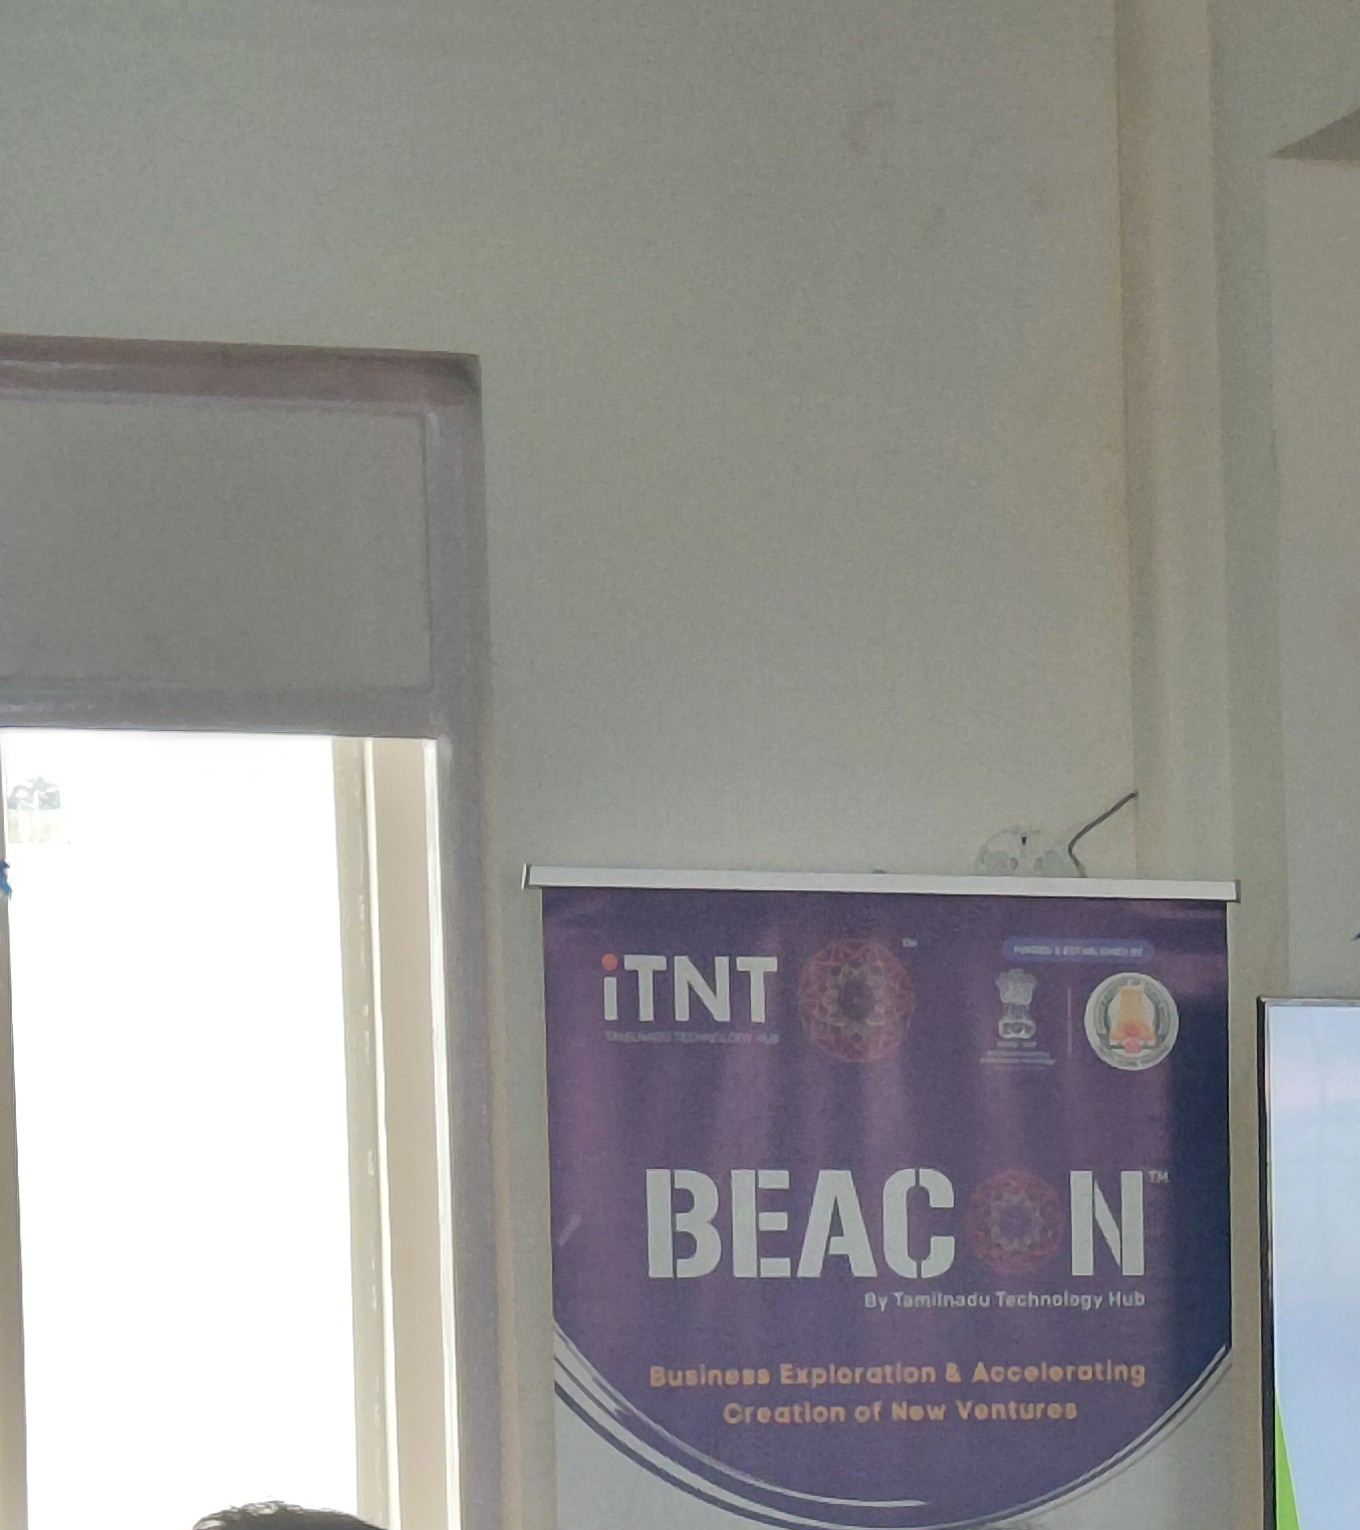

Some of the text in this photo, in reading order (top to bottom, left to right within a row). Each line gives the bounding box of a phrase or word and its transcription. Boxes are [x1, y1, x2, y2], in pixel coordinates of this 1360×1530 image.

[602, 953, 777, 1023] iTNT
[864, 1290, 1146, 1312] By Tamilnadu Technology Hub
[649, 1359, 1146, 1388] Business Exploration & Accelerating
[723, 1399, 1078, 1424] Creation of New Ventures
